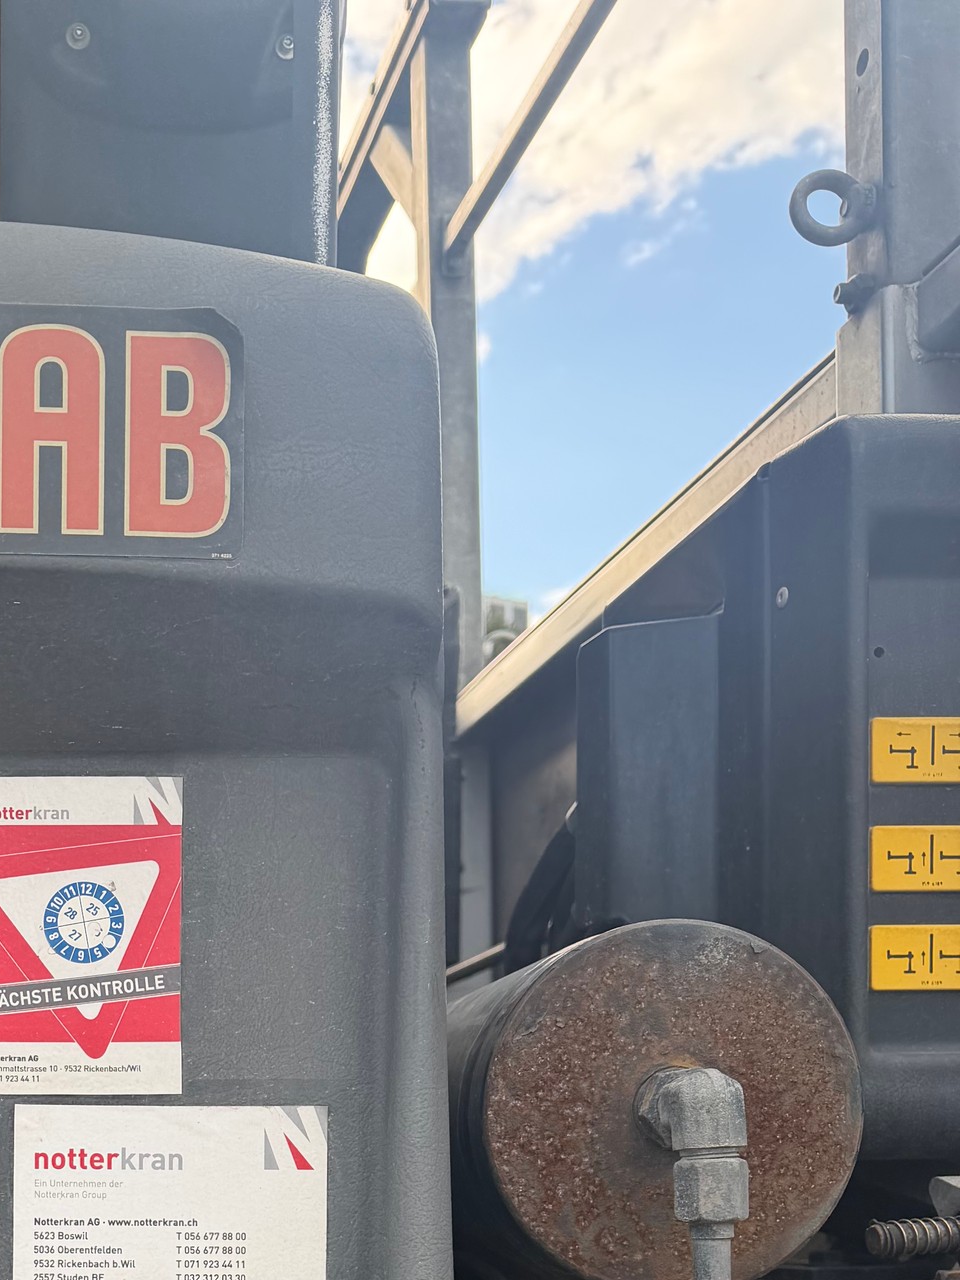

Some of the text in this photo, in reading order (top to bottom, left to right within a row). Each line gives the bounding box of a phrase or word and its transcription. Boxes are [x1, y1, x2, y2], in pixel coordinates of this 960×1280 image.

[64, 886, 76, 898] 11
[81, 884, 92, 894] 12
[100, 890, 107, 900] 1
[51, 897, 63, 910] 10
[64, 907, 77, 920] 28
[86, 903, 100, 916] 25
[108, 905, 119, 913] 2
[49, 932, 59, 940] 8
[68, 929, 82, 941] 27
[60, 945, 69, 955] 7
[78, 950, 84, 960] 6
[94, 948, 102, 958] 5
[66, 975, 165, 1000] KONTROLLE
[34, 1147, 184, 1170] notterkran
[35, 1180, 123, 1188] Ein Unternehmen der
[35, 1191, 107, 1200] Notterkran Group
[34, 1218, 85, 1227] Notterkran
[87, 1218, 100, 1227] AG
[108, 1218, 198, 1227] www.notterkran.ch
[34, 1232, 88, 1241] 5623 Boswil
[176, 1233, 246, 1241] T 056 677 88 00
[34, 1246, 122, 1255] 5036 Oberentfelden
[176, 1247, 246, 1255] T 056 677 88 00
[34, 1260, 136, 1268] 9532 Rickenbach b.Wil
[176, 1260, 245, 1268] T 071 923 44 11
